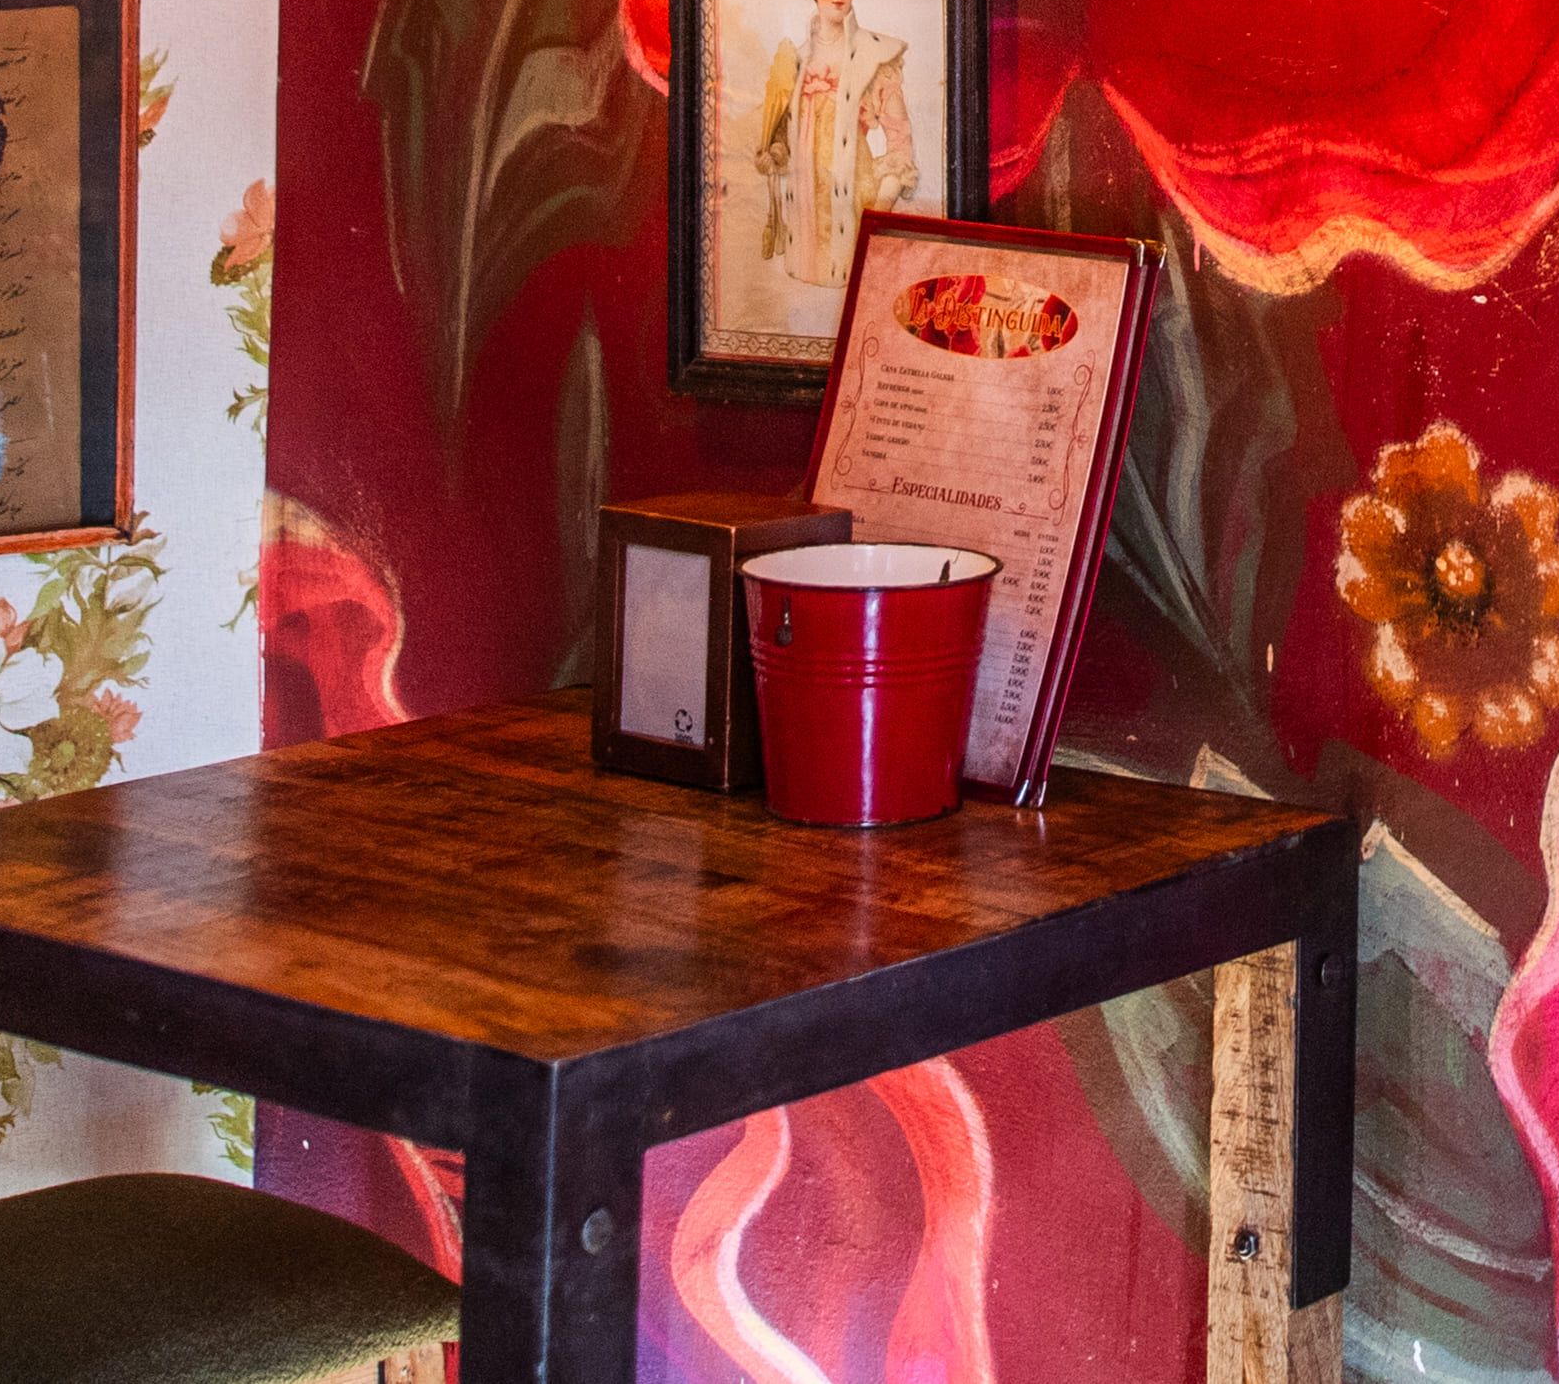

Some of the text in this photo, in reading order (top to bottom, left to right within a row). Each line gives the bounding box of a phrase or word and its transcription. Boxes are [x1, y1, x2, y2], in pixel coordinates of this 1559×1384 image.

[909, 287, 1063, 337] LA DISTINGUIDA
[892, 476, 1002, 511] ESPECIALIDADES
